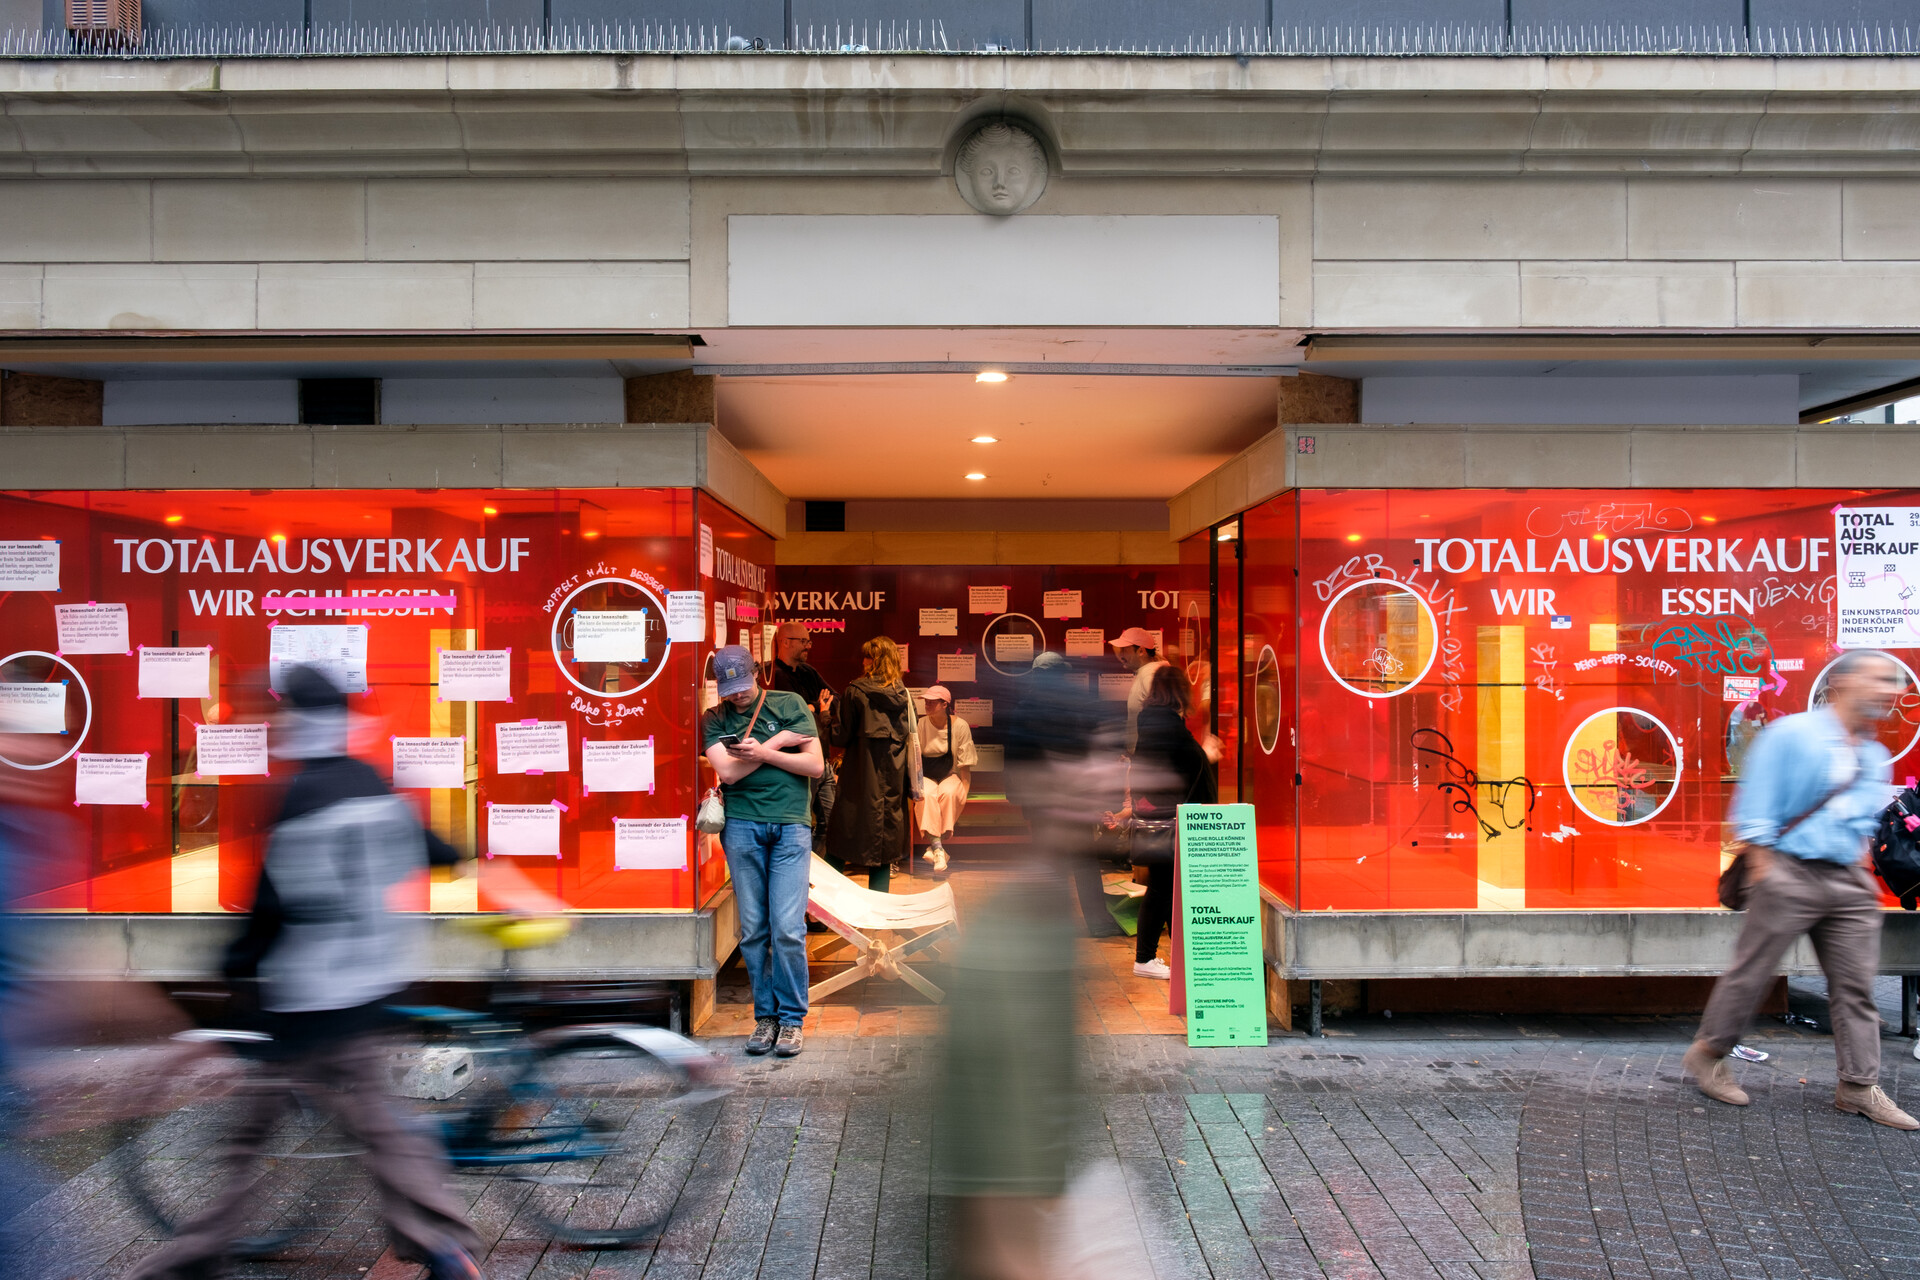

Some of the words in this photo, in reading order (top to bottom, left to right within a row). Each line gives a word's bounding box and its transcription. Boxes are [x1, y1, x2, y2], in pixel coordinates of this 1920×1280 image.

[1840, 514, 1894, 526] TOTAL
[1840, 528, 1876, 540] AUS
[113, 537, 530, 574] TOTALAUSVERKAUF
[1414, 537, 1830, 574] TOTALAUSVERKAUF
[1840, 543, 1919, 555] VERKAUF
[716, 546, 766, 593] TOTALAUSVERKAUF
[542, 574, 580, 613] DOPPELT
[586, 561, 618, 578] HÄLT
[188, 589, 256, 616] WIR
[1490, 589, 1558, 615] WIR
[1662, 588, 1755, 616] ESSEN
[1870, 616, 1904, 624] KÖLNER
[1186, 822, 1246, 831] INNENSTADT
[1191, 916, 1255, 925] AUSVERKAUF
